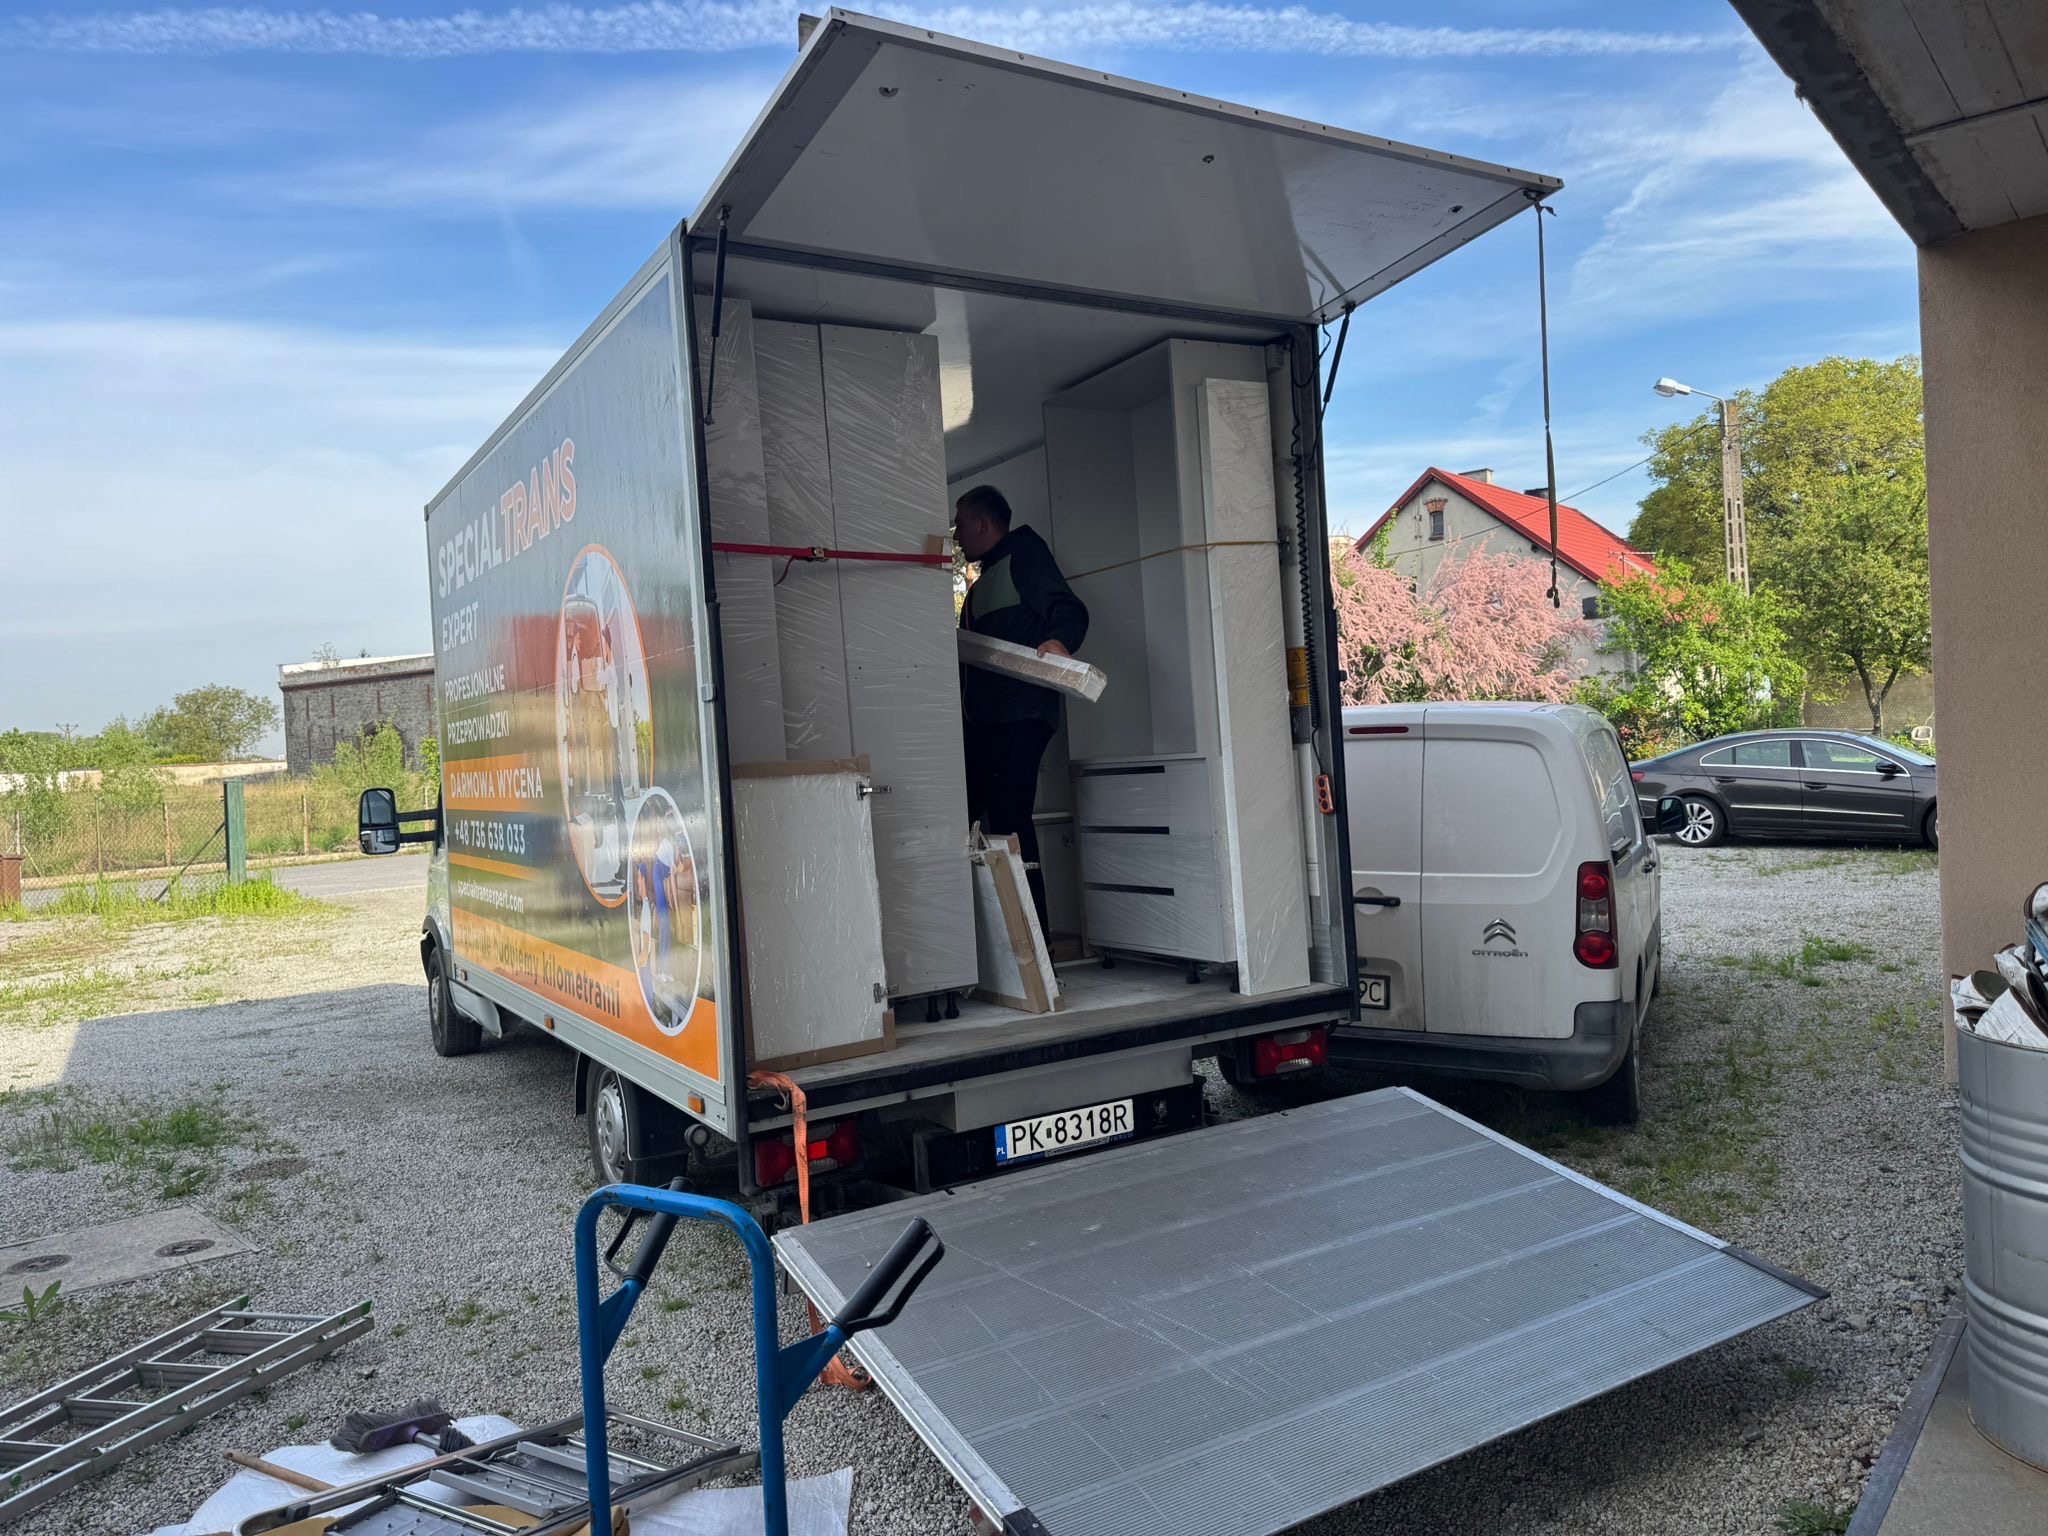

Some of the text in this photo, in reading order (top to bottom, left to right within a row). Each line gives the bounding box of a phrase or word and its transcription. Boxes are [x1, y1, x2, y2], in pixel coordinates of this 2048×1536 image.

[438, 437, 577, 599] SPECIALTRANS
[442, 601, 479, 651] EXPERT
[445, 663, 505, 703] PROFESJONALNE
[447, 710, 509, 745] PRZEPROWADZKI
[450, 767, 544, 799] DARMOWA WYCENA
[454, 822, 525, 854] +48 736 638 033
[457, 878, 524, 913] specialtransexpert.com
[542, 951, 621, 1019] kilometrami
[996, 1147, 1006, 1156] PL
[1012, 1121, 1045, 1155] PK
[1054, 1104, 1128, 1144] 8318R
